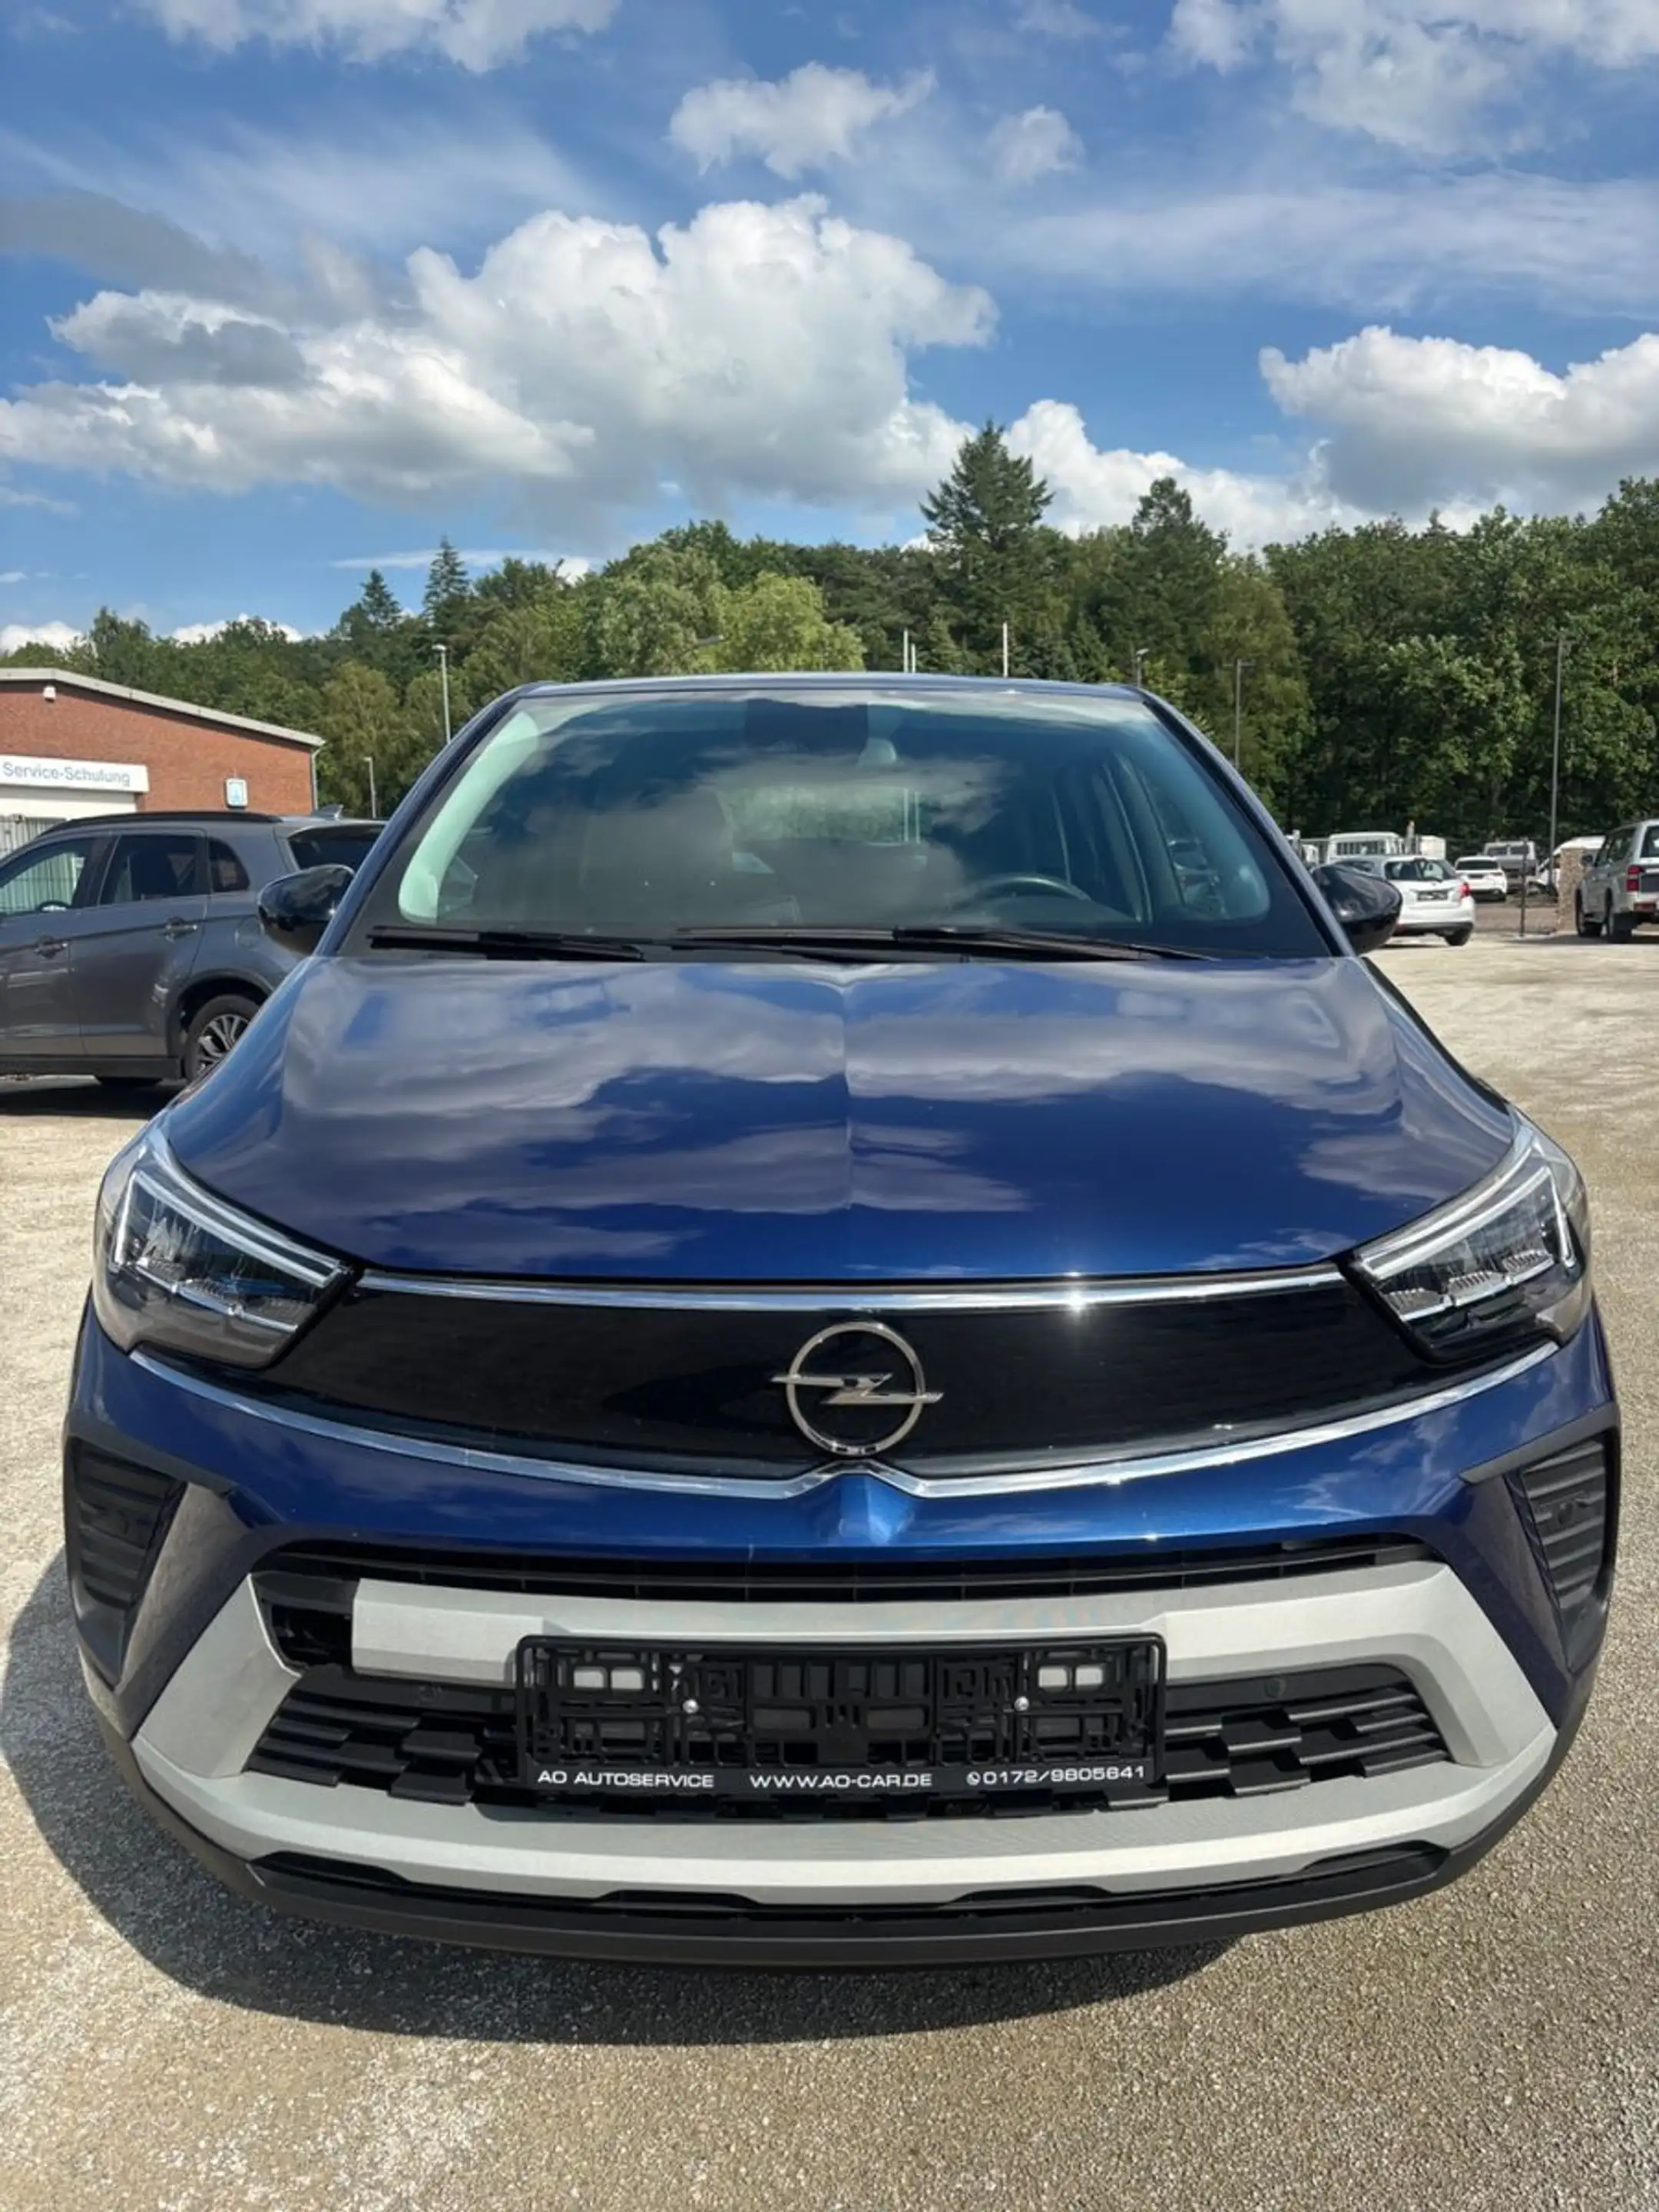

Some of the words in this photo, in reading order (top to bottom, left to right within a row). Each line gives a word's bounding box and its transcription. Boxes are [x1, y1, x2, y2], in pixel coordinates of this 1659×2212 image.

[3, 761, 131, 786] Service-Schulung
[537, 1770, 568, 1784] AO
[573, 1771, 714, 1788] AUTOSERVICE
[749, 1772, 932, 1788] WWW.AO-CAR.DE
